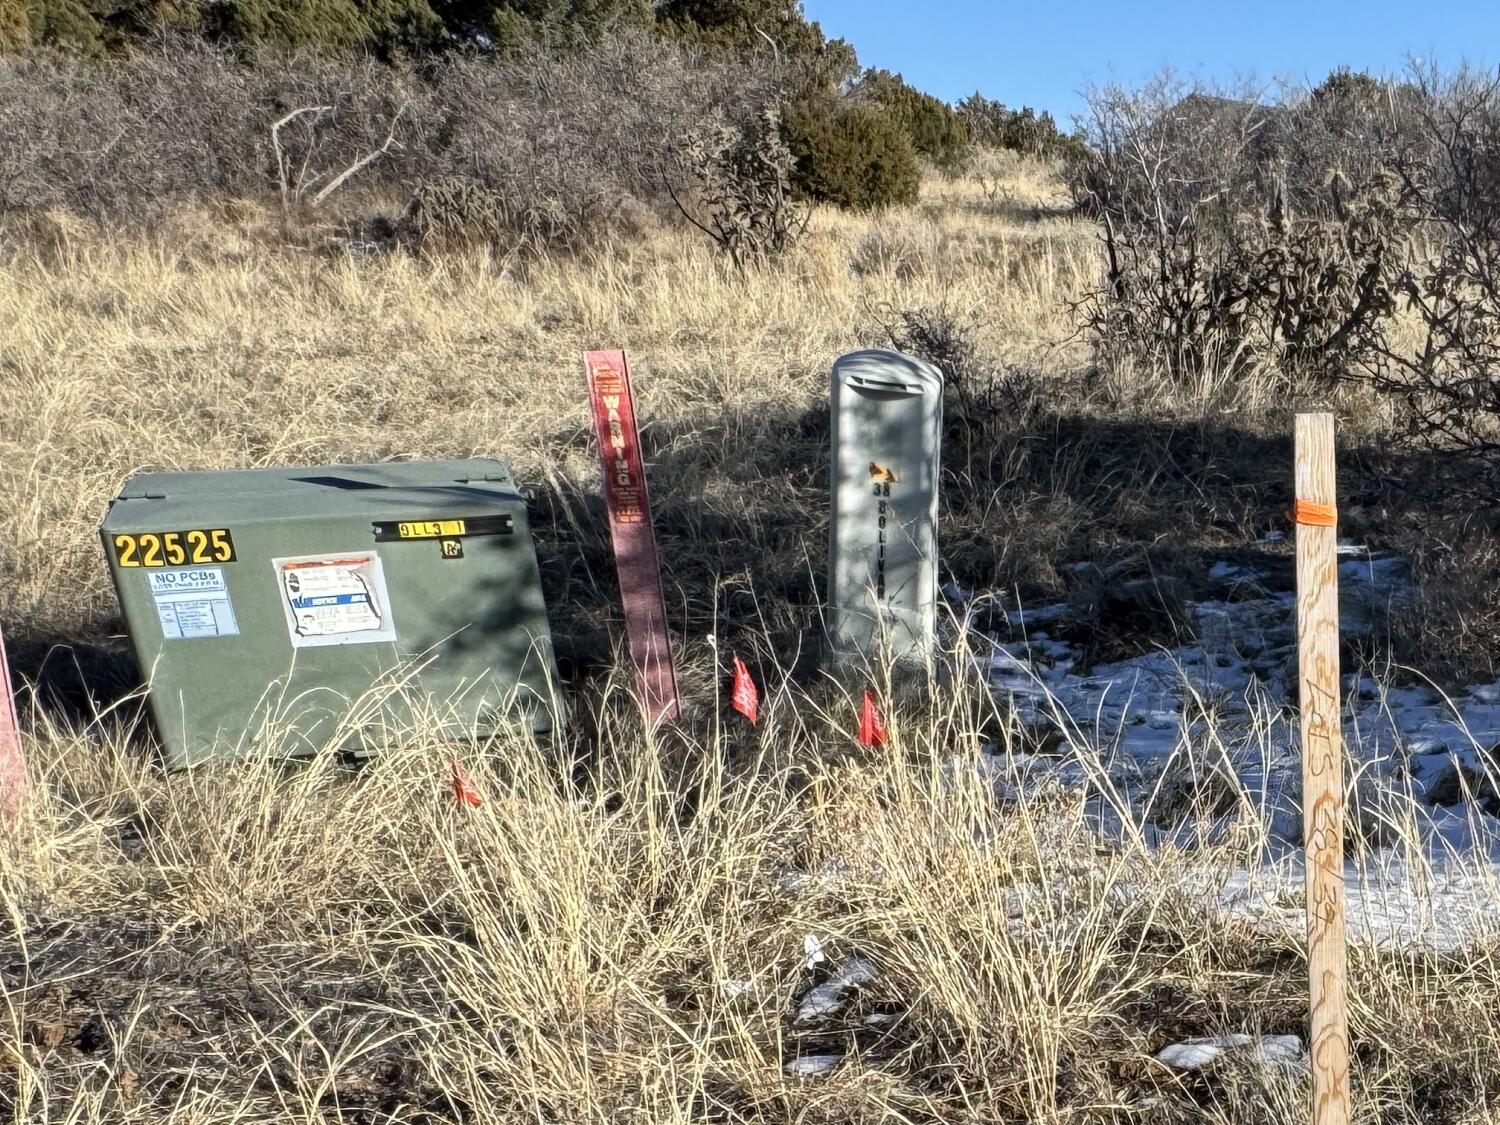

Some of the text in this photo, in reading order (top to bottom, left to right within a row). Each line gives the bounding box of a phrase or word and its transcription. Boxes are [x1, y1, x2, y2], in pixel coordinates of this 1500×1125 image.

[602, 395, 629, 486] WARNING
[115, 530, 232, 567] 22525
[155, 573, 176, 583] NO
